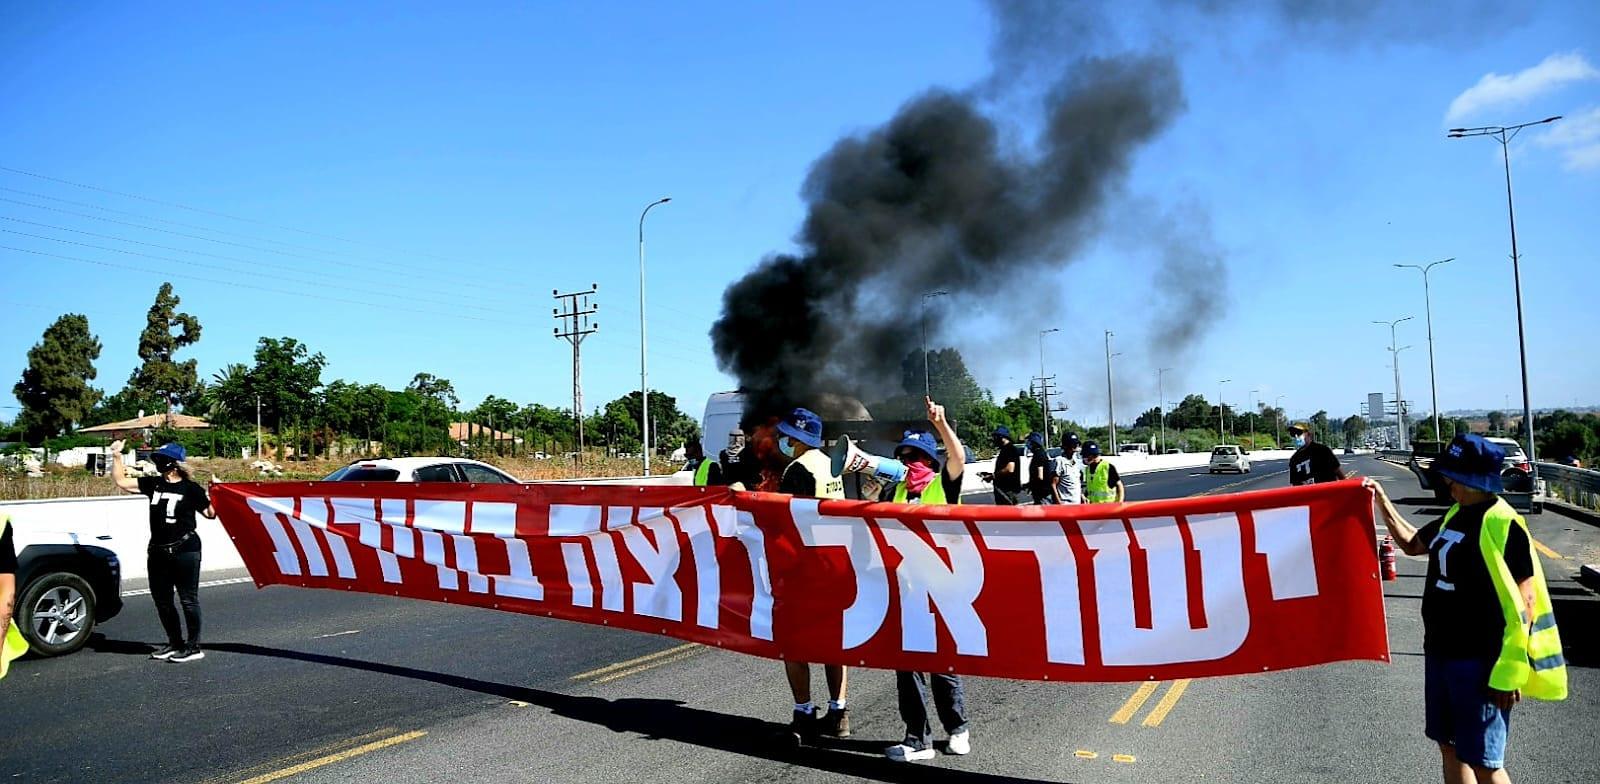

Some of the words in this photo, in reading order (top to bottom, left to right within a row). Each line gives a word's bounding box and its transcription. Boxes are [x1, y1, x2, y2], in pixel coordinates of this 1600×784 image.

[247, 497, 544, 600] בחירות
[548, 504, 773, 641] רוצה
[790, 498, 1319, 666] ישראל
